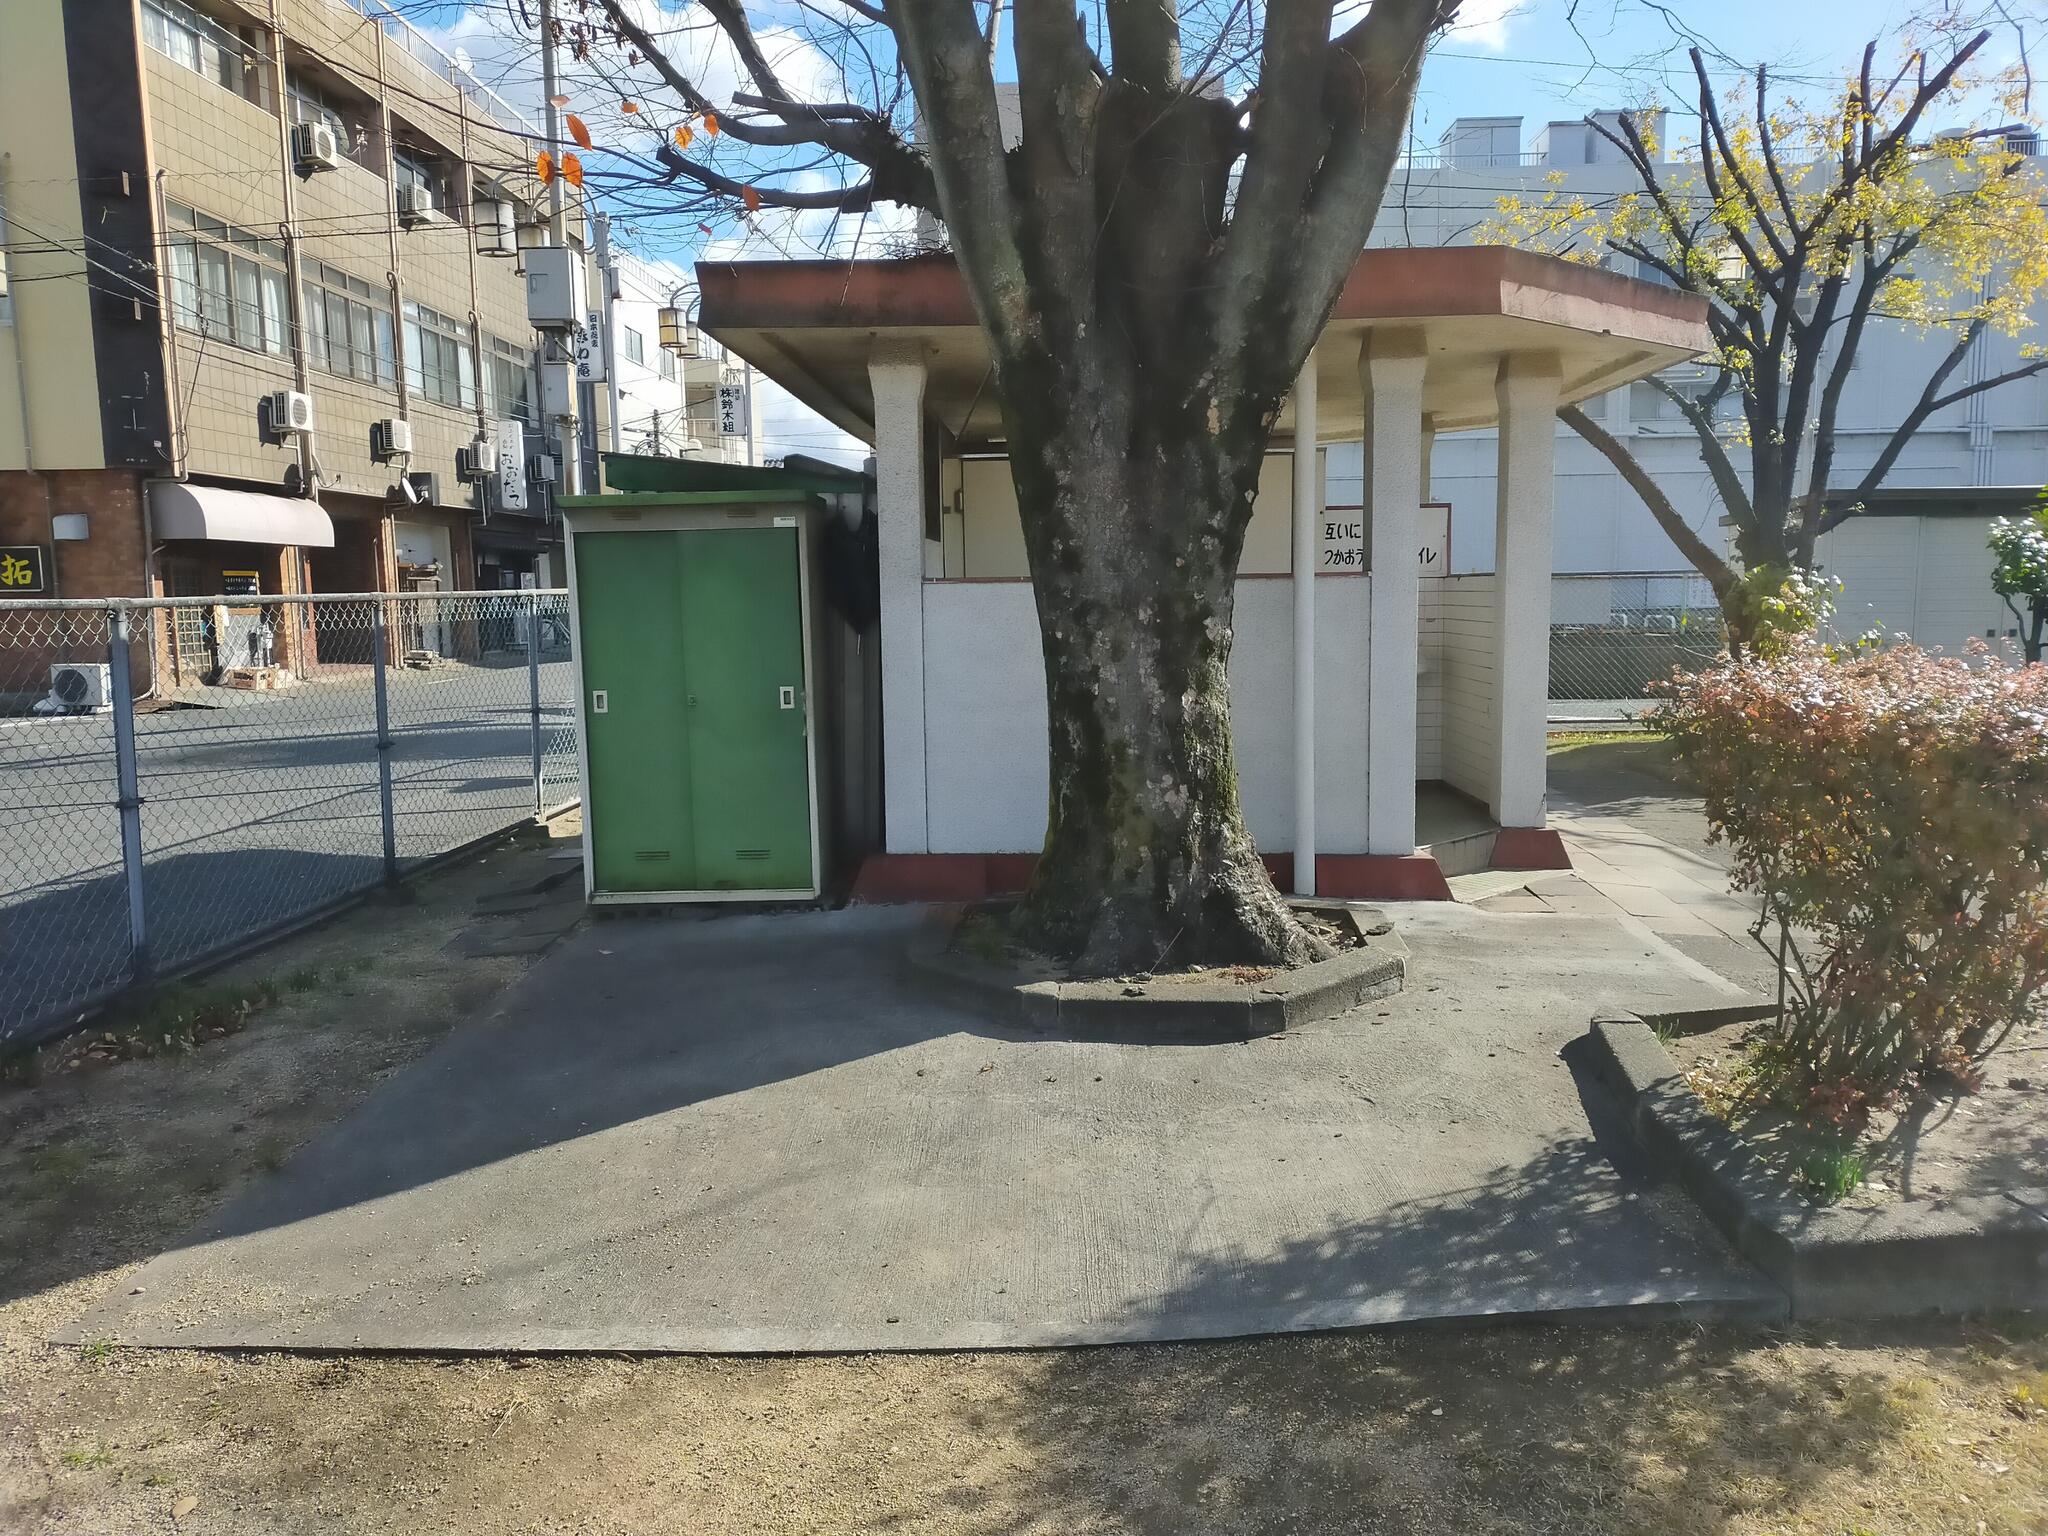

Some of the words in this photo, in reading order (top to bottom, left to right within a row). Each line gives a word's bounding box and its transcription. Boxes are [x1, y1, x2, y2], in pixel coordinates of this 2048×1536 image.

[1325, 523, 1361, 540] 互いに
[0, 553, 33, 586] 拓
